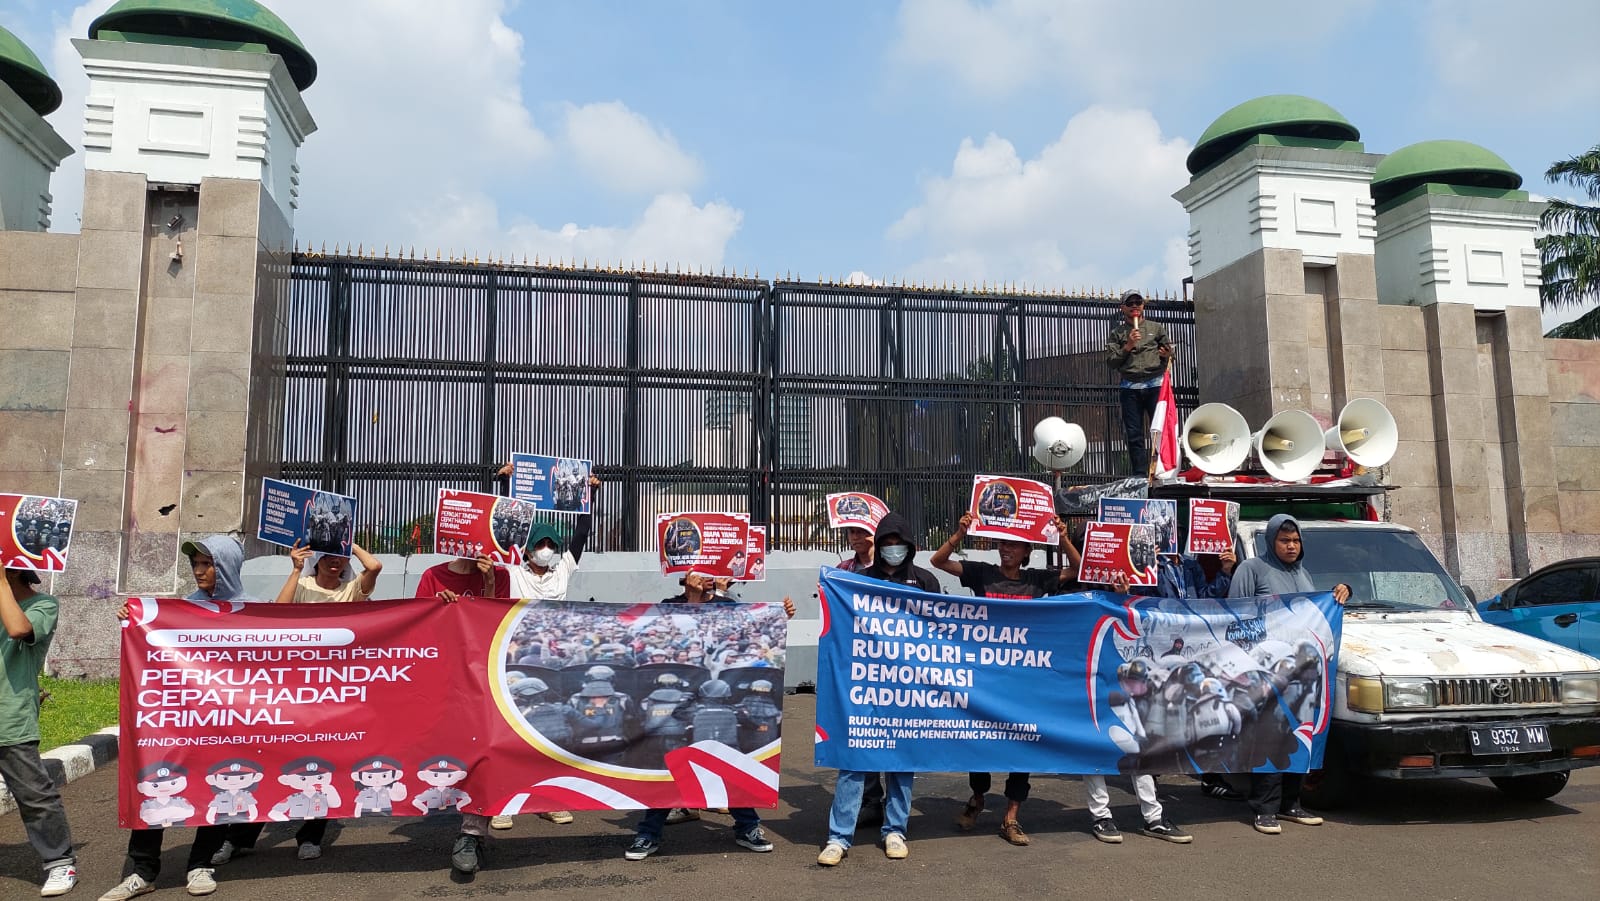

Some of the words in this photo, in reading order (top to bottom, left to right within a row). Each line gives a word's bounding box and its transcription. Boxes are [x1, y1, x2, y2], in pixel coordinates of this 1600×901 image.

[853, 594, 901, 614] MAU
[905, 598, 988, 620] NEGARA
[178, 634, 242, 643] DUKUNG
[245, 633, 276, 642] RUU
[280, 633, 322, 642] POLRI
[853, 616, 923, 638] KACAU
[928, 622, 958, 640] ???
[962, 624, 1029, 645] TOLAK
[147, 650, 234, 662] KENAPA
[238, 650, 282, 662] RUU
[287, 649, 347, 661] POLRI
[352, 646, 438, 660] PENTING
[852, 638, 900, 660] RUU
[904, 642, 960, 664] POLRI
[965, 652, 976, 662] =
[980, 647, 1052, 668] DUPAK
[140, 668, 292, 686] PERKUAT
[298, 665, 412, 684] TINDAK
[851, 662, 973, 688] DEMOKRASI
[137, 688, 244, 707] CEPAT
[250, 686, 366, 705] HADAPI
[850, 686, 968, 709] GADUNGAN
[136, 708, 294, 728] KRIMINAL
[848, 716, 871, 726] RUU
[872, 717, 902, 727] POLRI
[904, 718, 970, 728] MEMPERKUAT
[972, 720, 1037, 732] KEDAULATAN
[137, 732, 366, 747] #INDONESIABUTUHPOLRIKUAT
[848, 727, 890, 739] HUKUM,
[892, 728, 918, 739] YANG
[920, 730, 978, 740] MENENTANG
[980, 730, 1006, 740] PASTI
[1008, 732, 1041, 742] TAKUT
[848, 738, 885, 749] DIUSUT
[1472, 730, 1480, 746] B
[1491, 729, 1520, 745] 9352
[1526, 728, 1544, 744] MW
